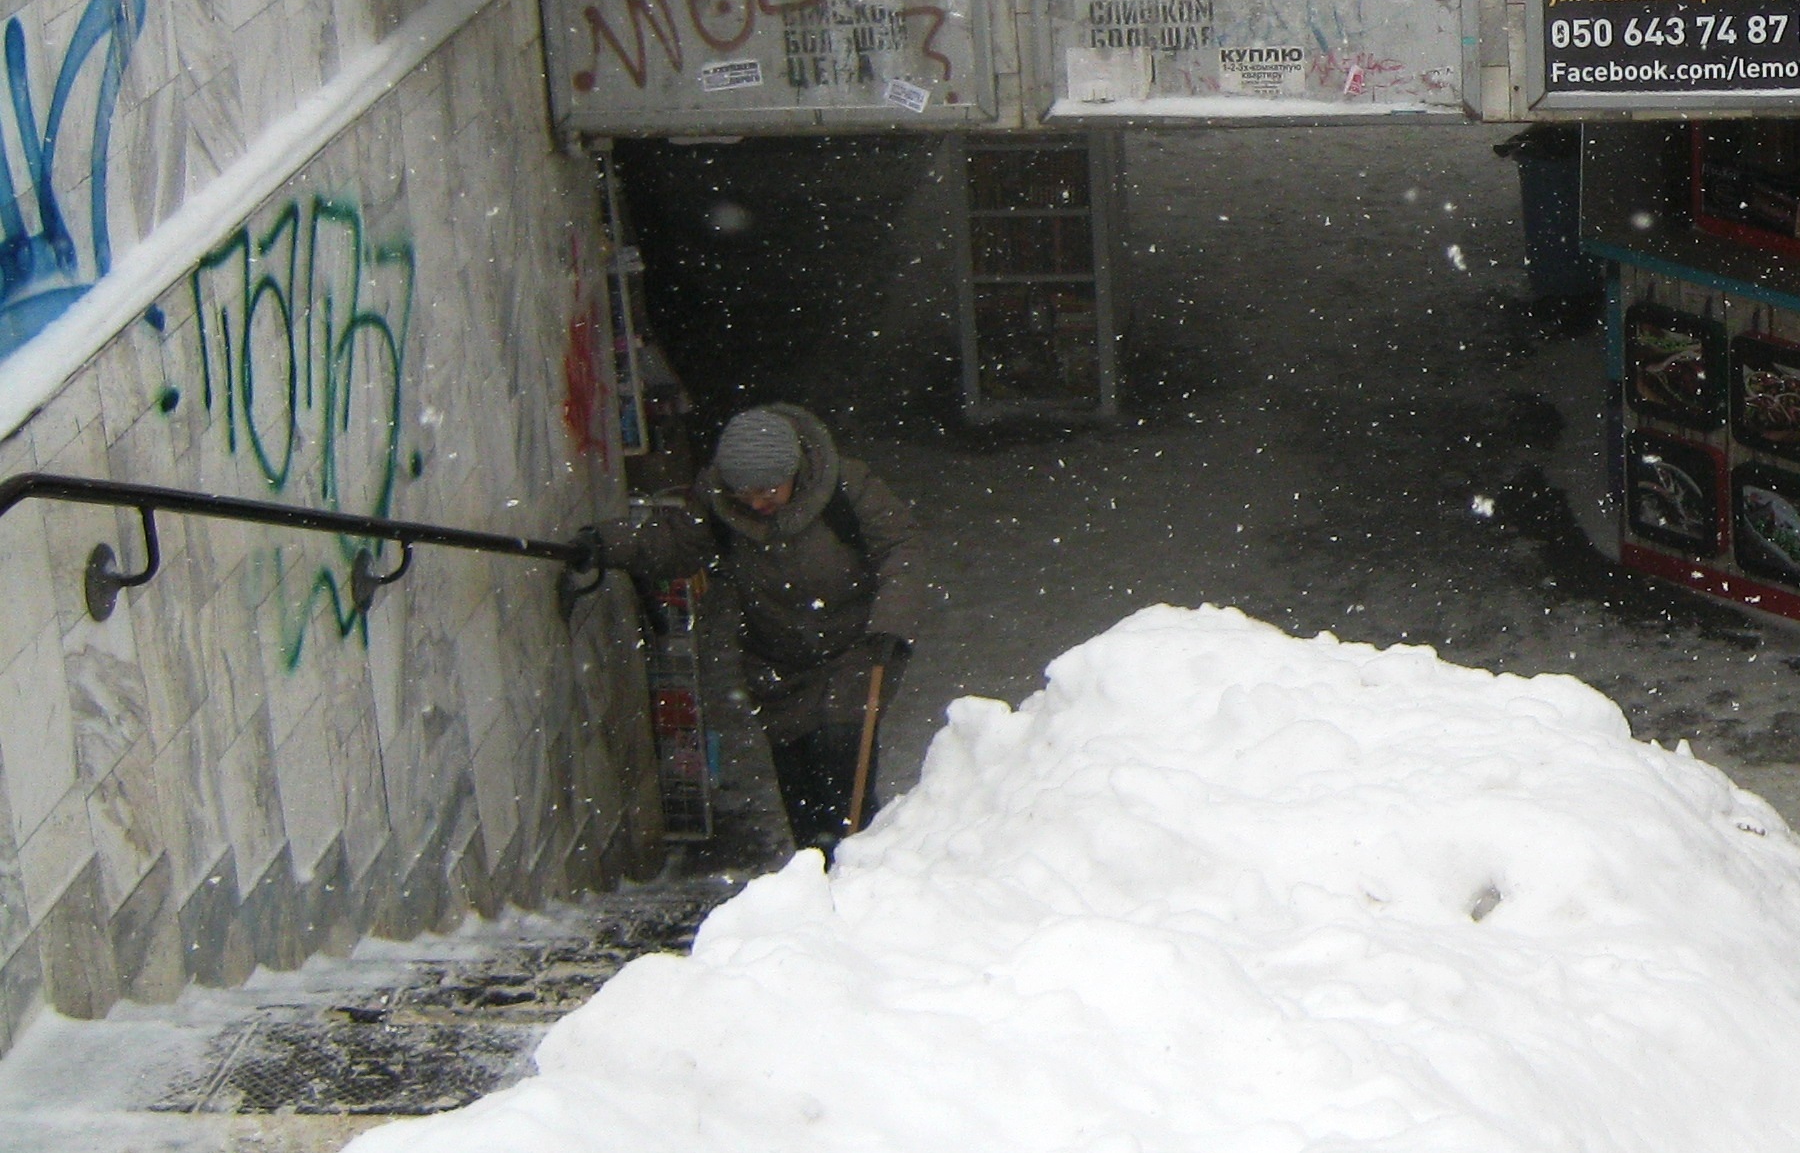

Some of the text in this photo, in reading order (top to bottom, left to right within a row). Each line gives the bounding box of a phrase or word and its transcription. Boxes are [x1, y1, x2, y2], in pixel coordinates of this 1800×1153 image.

[1551, 19, 1613, 48] 050
[1623, 17, 1687, 46] 643
[1696, 16, 1737, 46] 74
[1747, 15, 1788, 44] 87
[1221, 48, 1303, 63] КУПЛЮ
